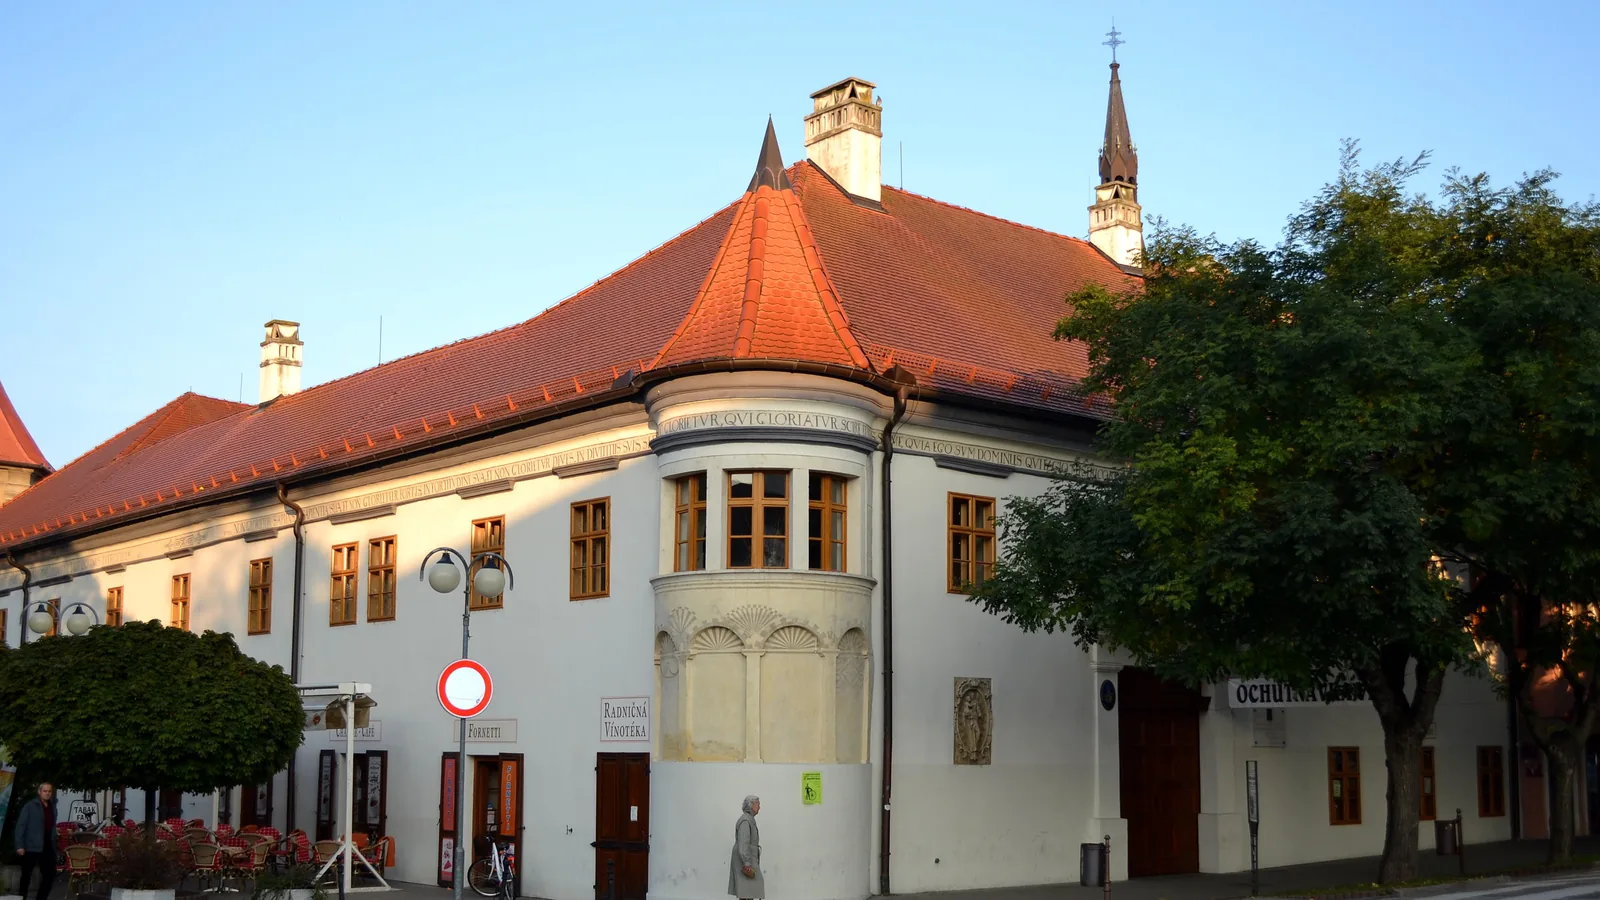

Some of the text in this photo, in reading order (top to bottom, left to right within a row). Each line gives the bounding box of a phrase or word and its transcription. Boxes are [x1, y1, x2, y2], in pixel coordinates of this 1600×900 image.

[724, 412, 753, 426] QVI
[756, 412, 838, 430] GLORIATVR
[468, 723, 501, 738] FORNETTI
[74, 806, 97, 814] TABAK
